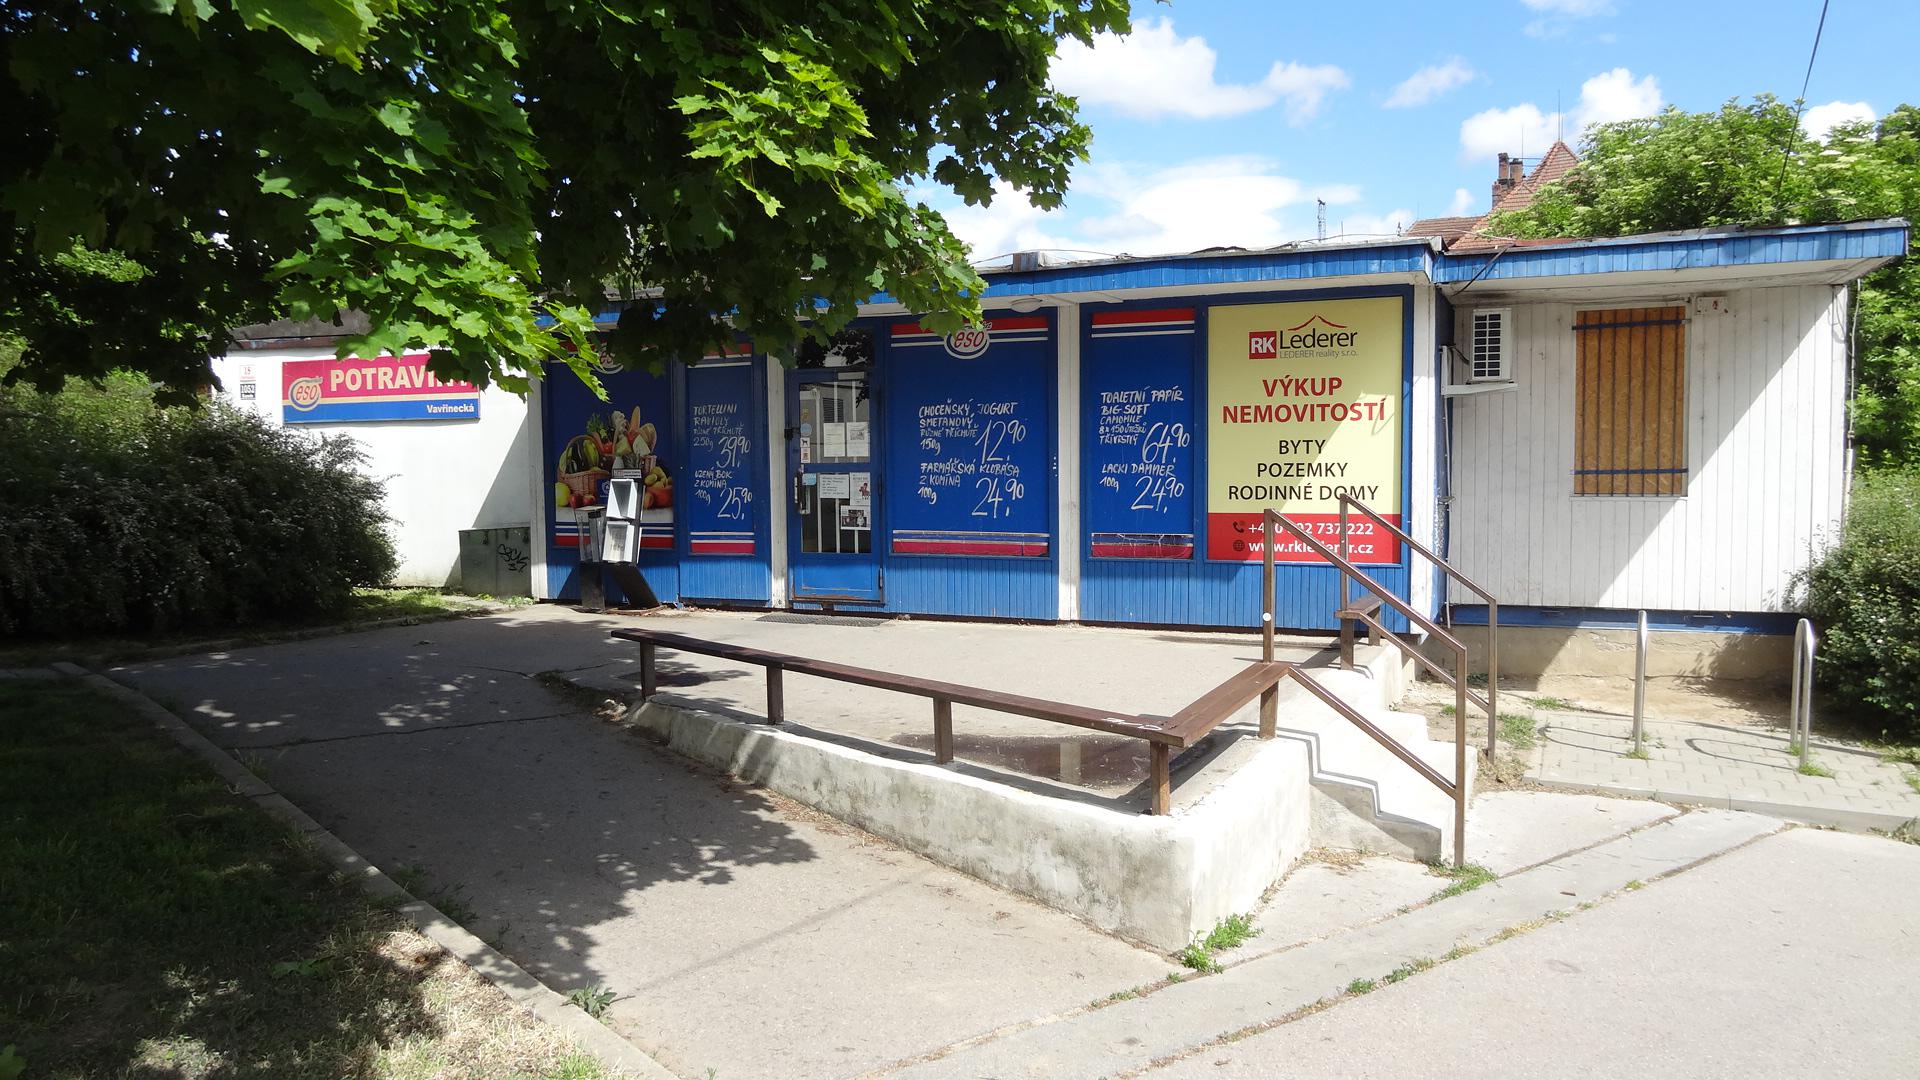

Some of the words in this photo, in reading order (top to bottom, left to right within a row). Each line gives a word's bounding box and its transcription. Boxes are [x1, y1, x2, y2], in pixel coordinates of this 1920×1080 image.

[954, 331, 985, 348] eso
[1251, 336, 1276, 354] RK
[1280, 328, 1358, 349] Lederer
[1280, 350, 1315, 359] LEDERER
[1316, 349, 1340, 359] reality
[330, 365, 468, 392] POTRAVI
[1262, 375, 1343, 397] VÝKUP
[296, 385, 318, 401] eso
[1100, 386, 1151, 404] TOALETNÍ
[1151, 385, 1185, 402] PAPÍR
[427, 403, 475, 413] Vavřinecká
[919, 398, 974, 418] CHOCEŇSKÝ
[977, 402, 1018, 415] JOGURT
[1101, 405, 1122, 416] BIG
[1123, 403, 1151, 415] SOFT
[1222, 397, 1386, 424] NEMOVITOSTÍ
[919, 413, 975, 429] SMETANOVÝ
[1279, 439, 1326, 455] BYTY
[920, 458, 976, 475] FARMÁŘSKÁ
[979, 462, 1020, 478] KLOBÁSA
[1257, 462, 1348, 477] POZEMKY
[1228, 482, 1313, 500] RODINNÉ
[1319, 486, 1379, 501] DOMY
[1316, 522, 1341, 534] 737
[1347, 523, 1374, 535] 222
